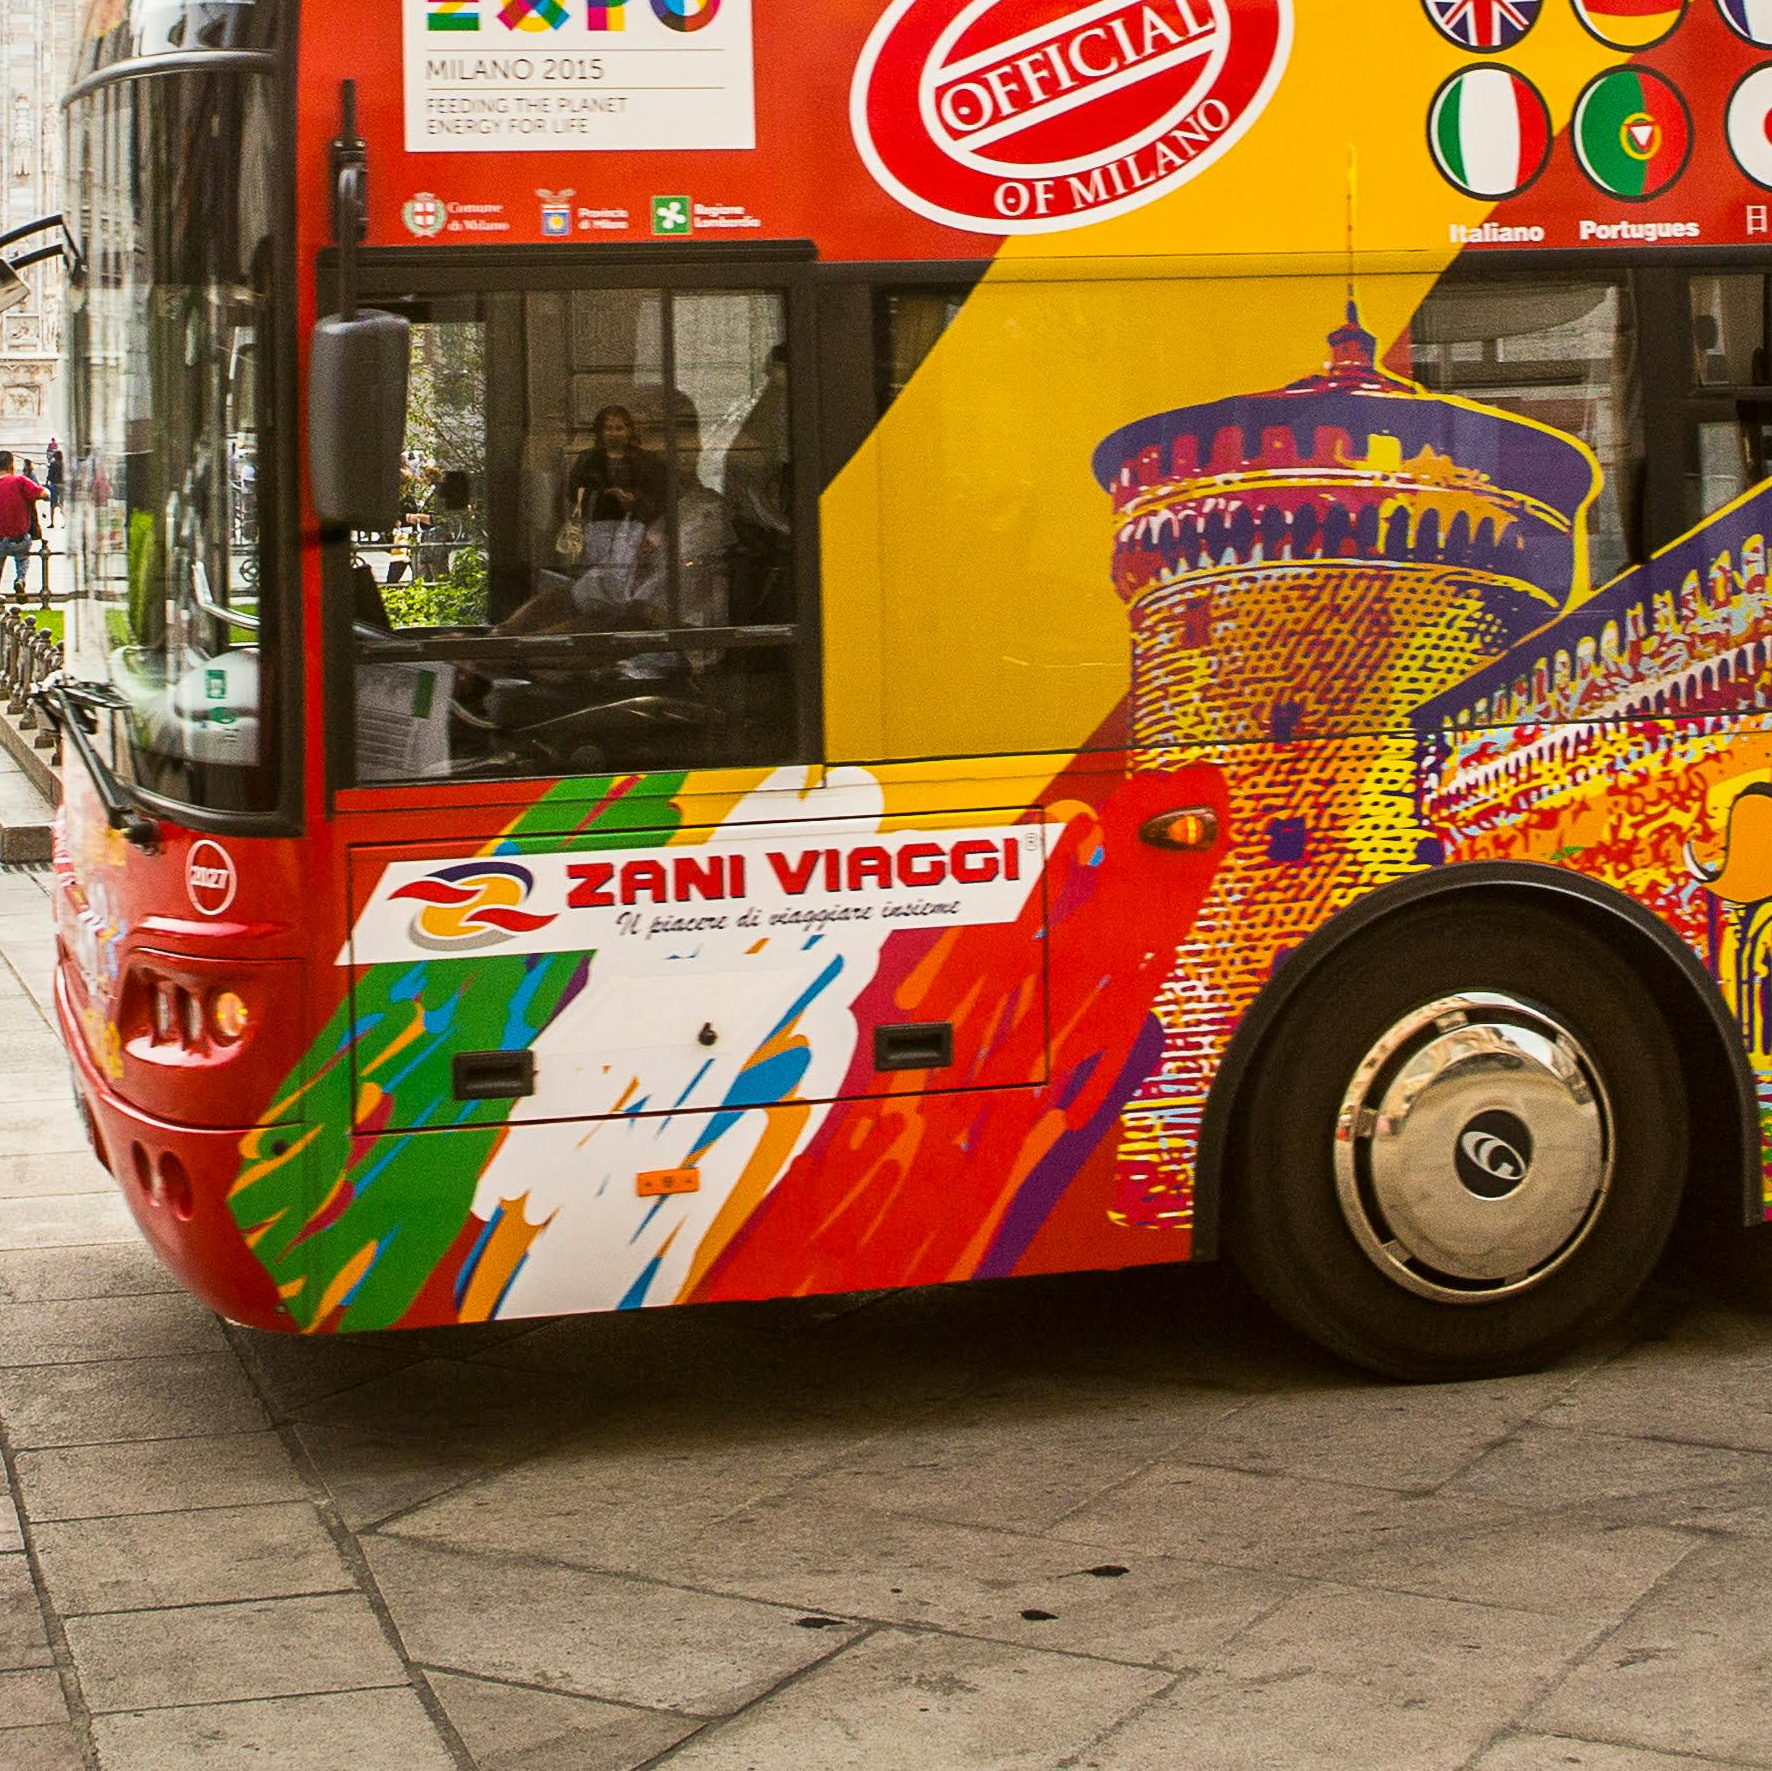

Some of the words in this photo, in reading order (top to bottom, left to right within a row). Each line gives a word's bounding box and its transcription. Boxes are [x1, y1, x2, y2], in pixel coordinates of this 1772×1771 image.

[426, 58, 534, 81] MILANO
[544, 58, 604, 81] 2015
[427, 97, 508, 115] FEEDING
[515, 97, 551, 114] THE
[558, 97, 629, 114] PLANET
[427, 118, 502, 135] ENERGY
[509, 118, 546, 135] FOR
[553, 117, 590, 134] LIFE
[994, 179, 1055, 217] OF
[1065, 97, 1231, 212] MILANO
[1448, 222, 1545, 244] Italiano
[1579, 219, 1700, 242] Portugues
[566, 854, 746, 908] ZANI
[766, 837, 1020, 895] VIAGGI
[616, 911, 639, 937] Il
[646, 912, 727, 939] piacere
[737, 906, 759, 928] di
[768, 903, 874, 931] viaggiare
[880, 898, 962, 917] insieme
